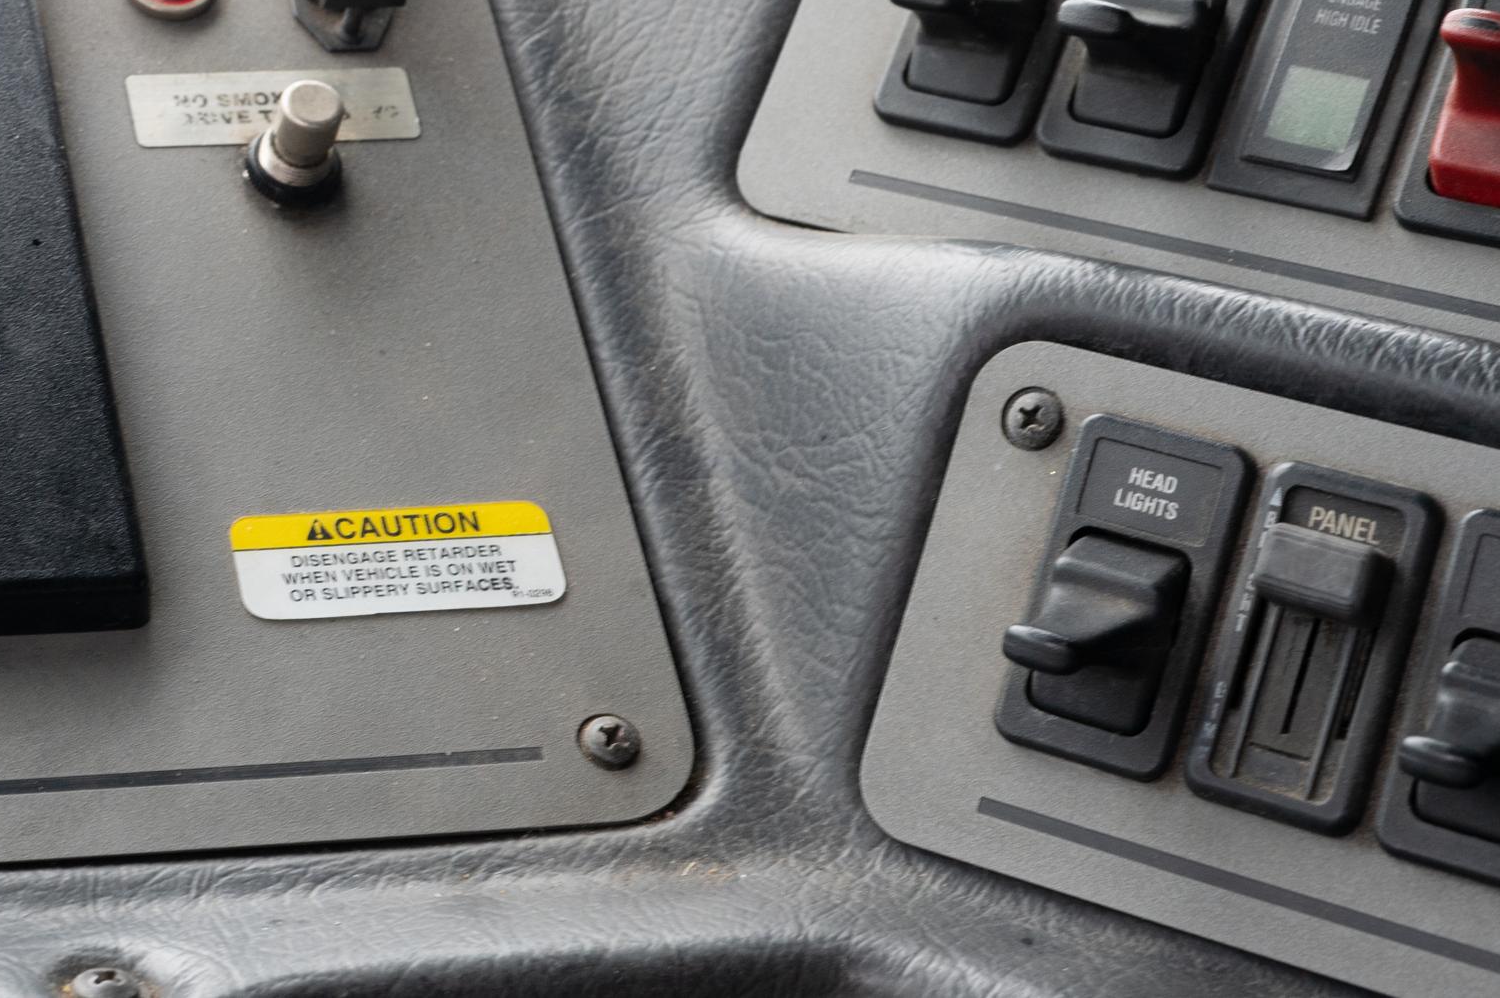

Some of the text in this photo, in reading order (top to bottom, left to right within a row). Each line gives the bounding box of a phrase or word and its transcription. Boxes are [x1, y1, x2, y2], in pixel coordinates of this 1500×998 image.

[1314, 9, 1382, 35] HIGH IDLE
[1127, 467, 1178, 495] HEAD
[1113, 488, 1180, 520] LIGHTS
[335, 510, 481, 540] CAUTION
[1308, 505, 1380, 545] PANEL
[291, 544, 502, 568] DISENGAGE RETARDER
[282, 560, 517, 585] WHEN VEHICLE IS ON WET
[288, 577, 519, 602] OR SLIPPERY SURFACES.
